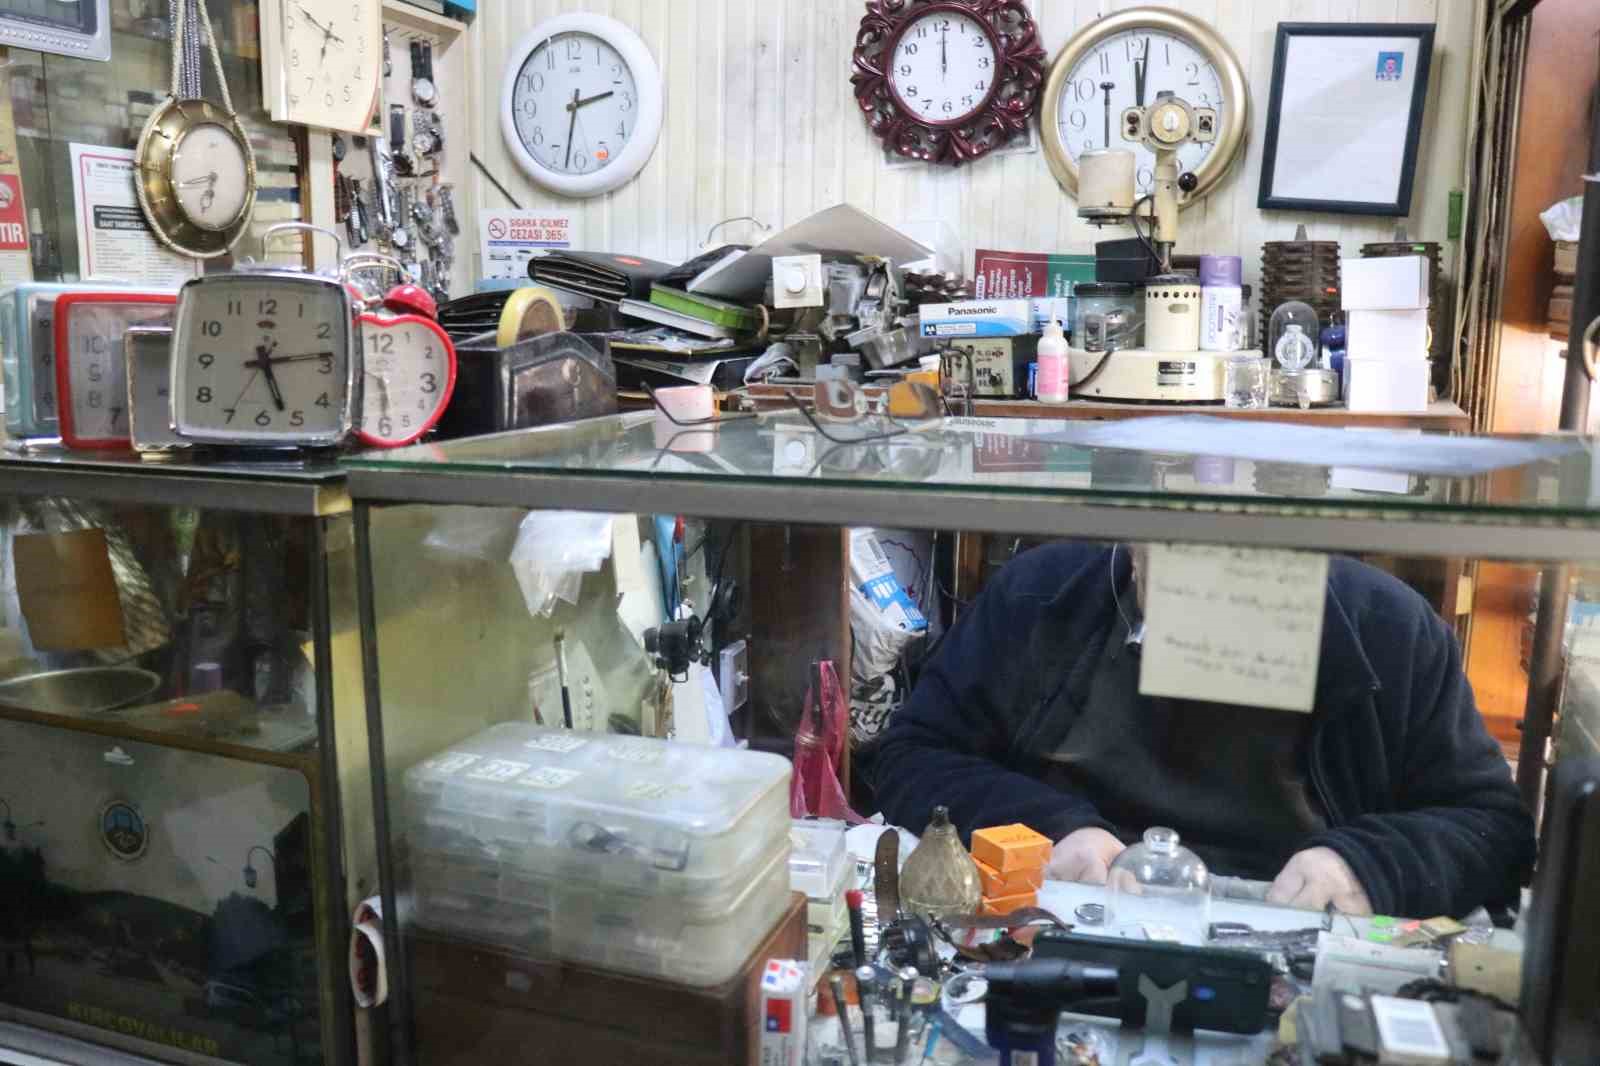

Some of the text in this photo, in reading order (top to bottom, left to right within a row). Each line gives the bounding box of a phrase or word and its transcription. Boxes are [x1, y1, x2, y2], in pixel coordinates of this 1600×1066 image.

[916, 28, 927, 39] 11
[933, 20, 951, 33] 12
[567, 39, 582, 60] 12
[904, 43, 918, 55] 10
[974, 36, 985, 48] 2
[1125, 38, 1145, 62] 12
[901, 65, 912, 76] 9
[978, 57, 989, 69] 3
[1099, 51, 1110, 75] 11
[526, 71, 544, 93] 10
[610, 63, 623, 85] 2
[1184, 63, 1200, 86] 2
[906, 86, 918, 97] 8
[975, 80, 985, 91] 4
[1073, 79, 1096, 103] 10
[524, 98, 537, 119] 9
[620, 91, 632, 112] 3
[922, 99, 933, 111] 7
[942, 101, 952, 113] 6
[961, 95, 973, 107] 5
[1070, 109, 1087, 131] 9
[532, 126, 544, 146] 8
[616, 120, 627, 141] 4
[574, 151, 587, 171] 6
[1137, 165, 1153, 186] 6
[227, 301, 243, 316] 11
[258, 299, 278, 315] 12
[947, 305, 998, 317] Panasonic
[202, 321, 223, 338] 10
[317, 323, 332, 340] 2
[368, 333, 394, 352] 12
[424, 345, 433, 357] 2
[198, 354, 215, 369] 9
[419, 373, 437, 394] 3
[196, 387, 213, 403] 8
[314, 392, 331, 408] 4
[108, 406, 121, 425] 7
[224, 408, 237, 425] 7
[255, 410, 271, 426] 6
[290, 410, 304, 427] 5
[377, 416, 393, 437] 6
